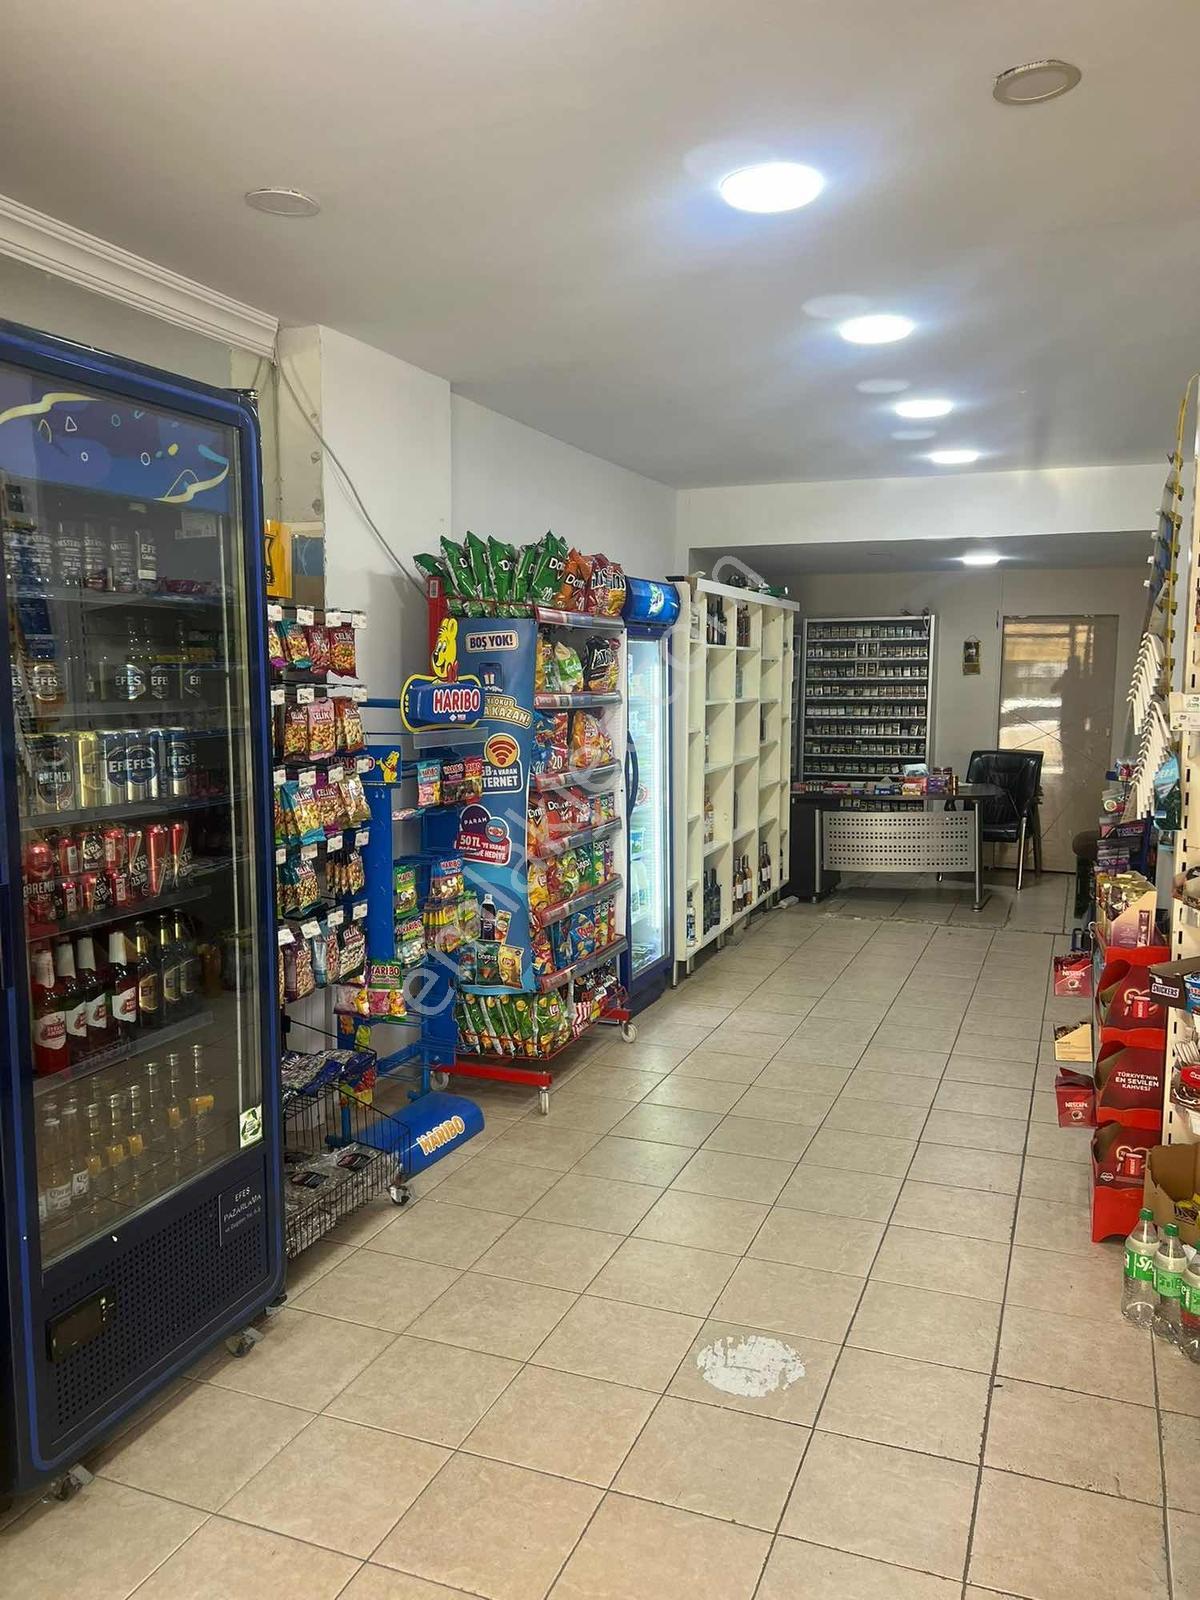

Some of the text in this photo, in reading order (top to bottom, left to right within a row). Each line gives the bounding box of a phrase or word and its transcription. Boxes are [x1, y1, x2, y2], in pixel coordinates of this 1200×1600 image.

[470, 634, 513, 650] BOŞ YOK!
[32, 675, 58, 687] EFES
[115, 675, 142, 686] EFES
[433, 688, 481, 714] HARIBO
[492, 706, 531, 725] KAZAN!
[125, 757, 156, 770] EFES
[482, 775, 518, 788] TERNET
[464, 817, 487, 825] PARAM
[460, 835, 471, 846] 50
[371, 965, 400, 977] HARIBO
[1152, 984, 1179, 998] SNICKERS
[416, 1115, 465, 1156] HARIBO
[234, 1186, 251, 1202] EFES
[223, 1194, 262, 1223] PAZARLAMA
